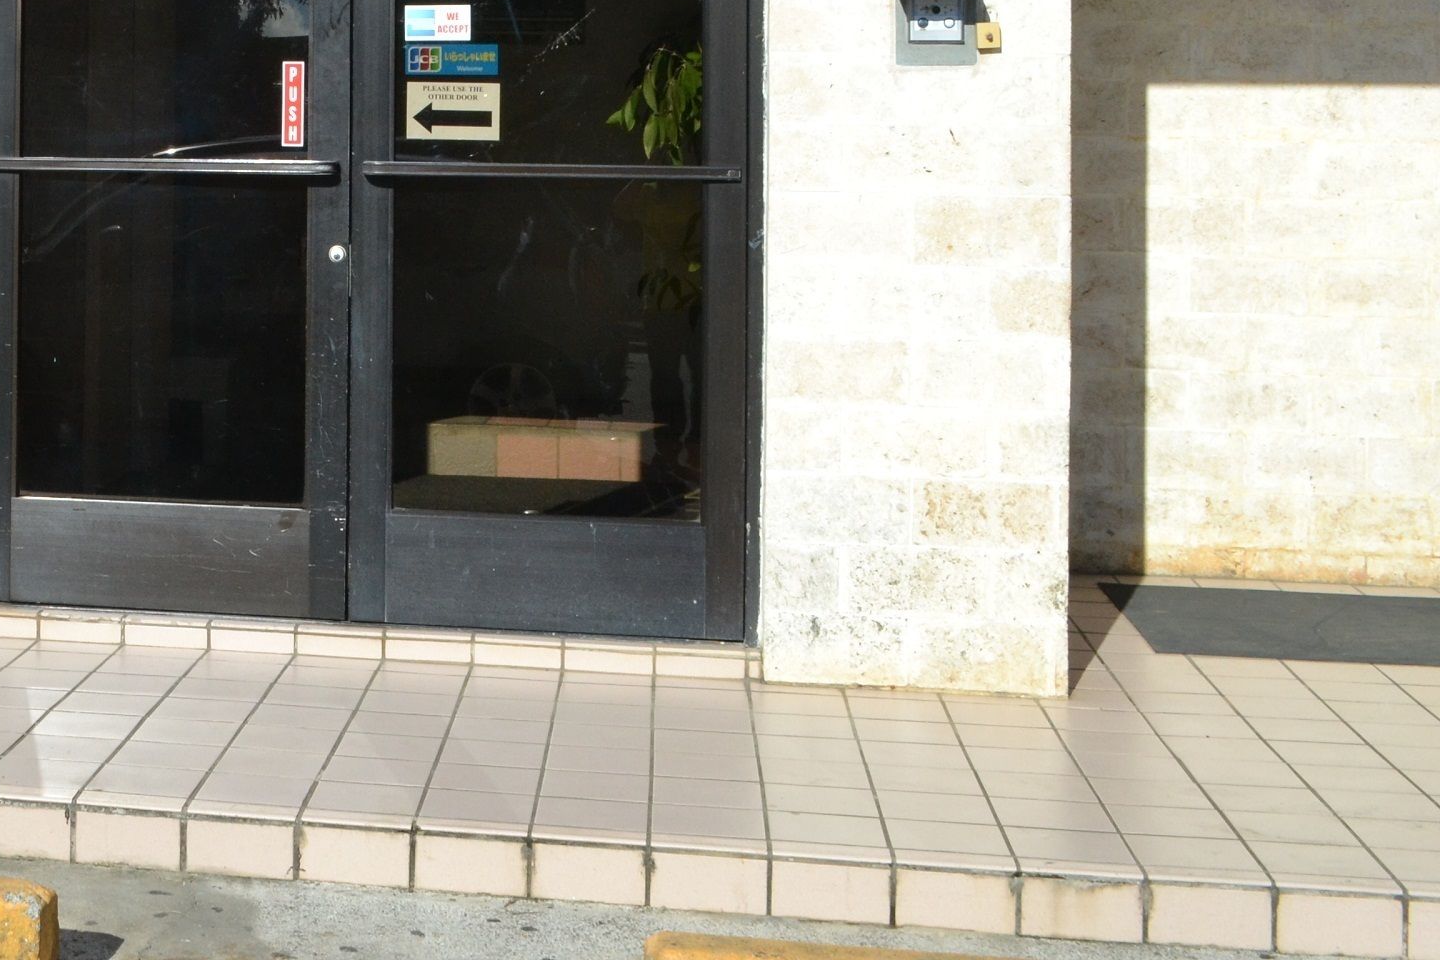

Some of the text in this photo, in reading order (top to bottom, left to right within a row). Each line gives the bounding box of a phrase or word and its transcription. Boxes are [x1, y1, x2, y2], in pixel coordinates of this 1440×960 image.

[446, 12, 459, 21] WE
[437, 24, 469, 33] ACCEPT
[288, 66, 298, 142] PUSH
